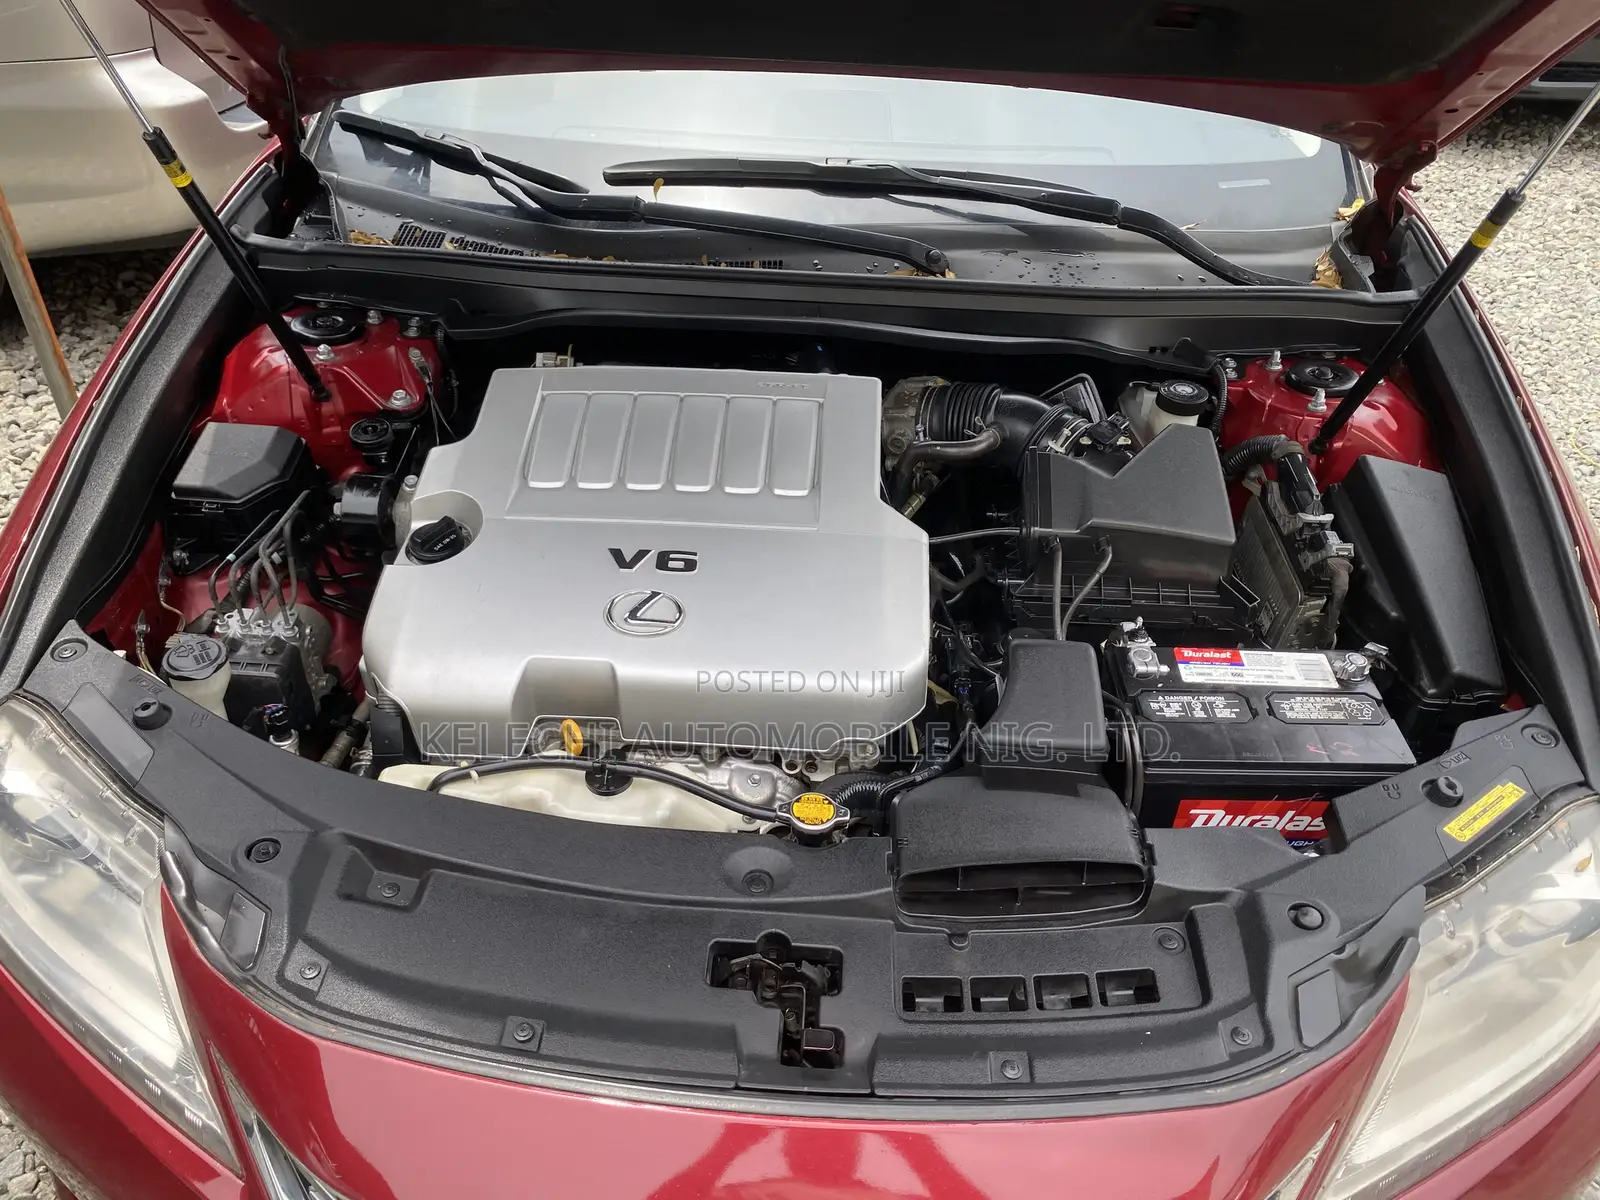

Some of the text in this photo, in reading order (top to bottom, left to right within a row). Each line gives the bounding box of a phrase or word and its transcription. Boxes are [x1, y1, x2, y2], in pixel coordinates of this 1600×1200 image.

[608, 547, 698, 573] V6
[1181, 649, 1232, 659] Duralast
[1189, 809, 1327, 832] Duralas
